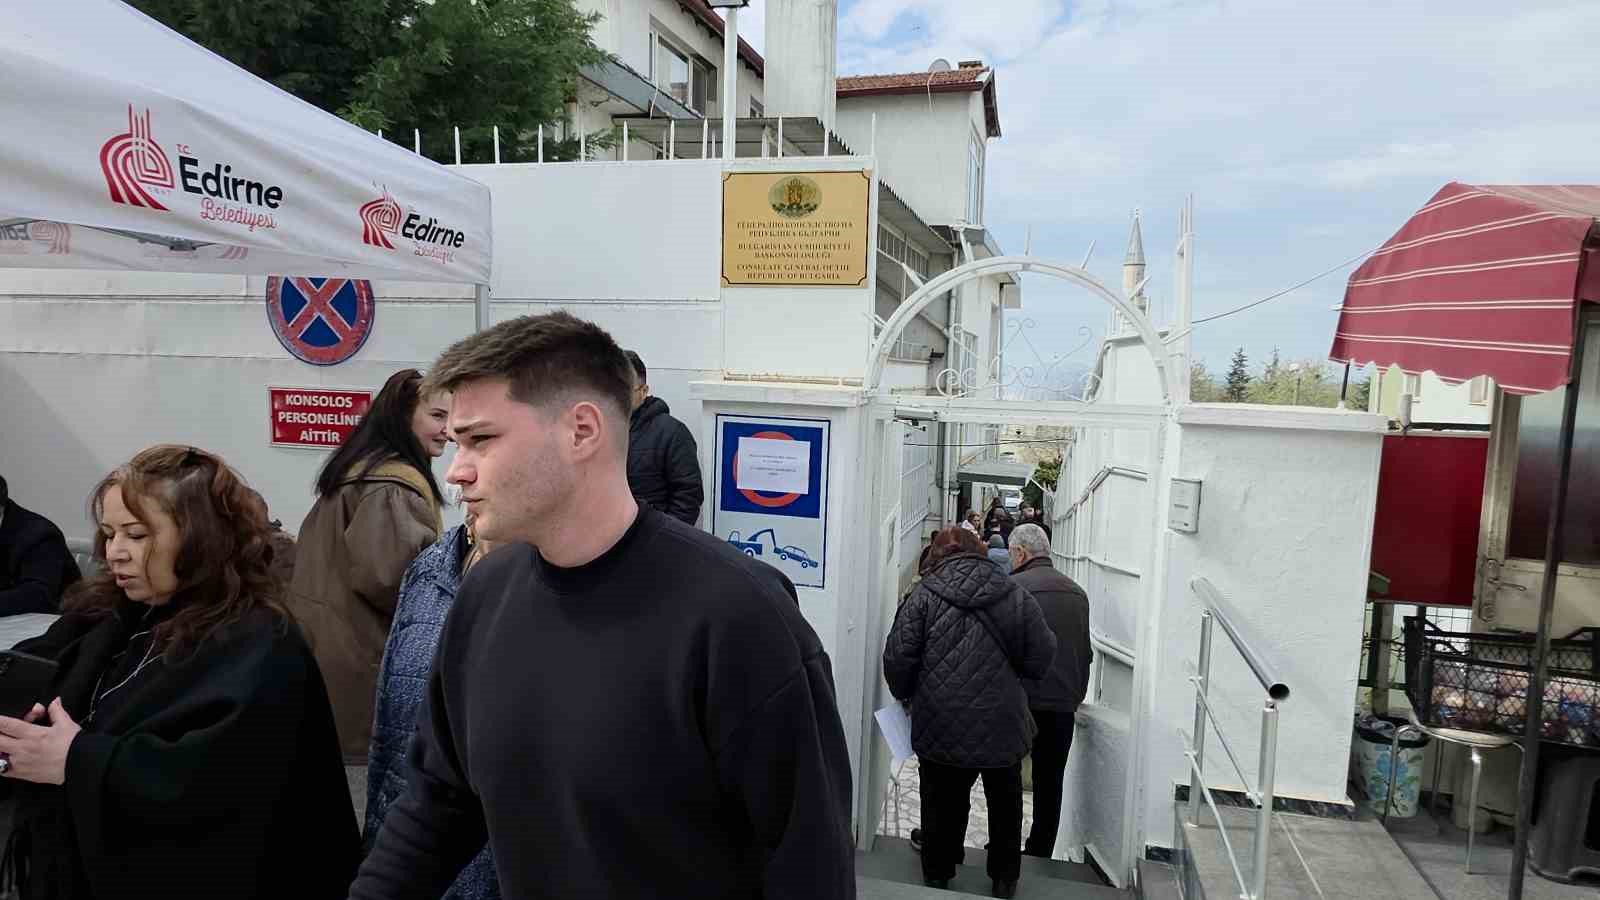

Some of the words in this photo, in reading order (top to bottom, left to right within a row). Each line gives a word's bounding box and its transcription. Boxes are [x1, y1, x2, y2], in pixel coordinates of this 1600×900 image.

[179, 155, 283, 209] Edirne
[201, 197, 277, 232] Belediyesi
[402, 213, 465, 249] Edirne
[285, 394, 353, 408] KONSOLOS
[300, 428, 340, 443] AİTTİR
